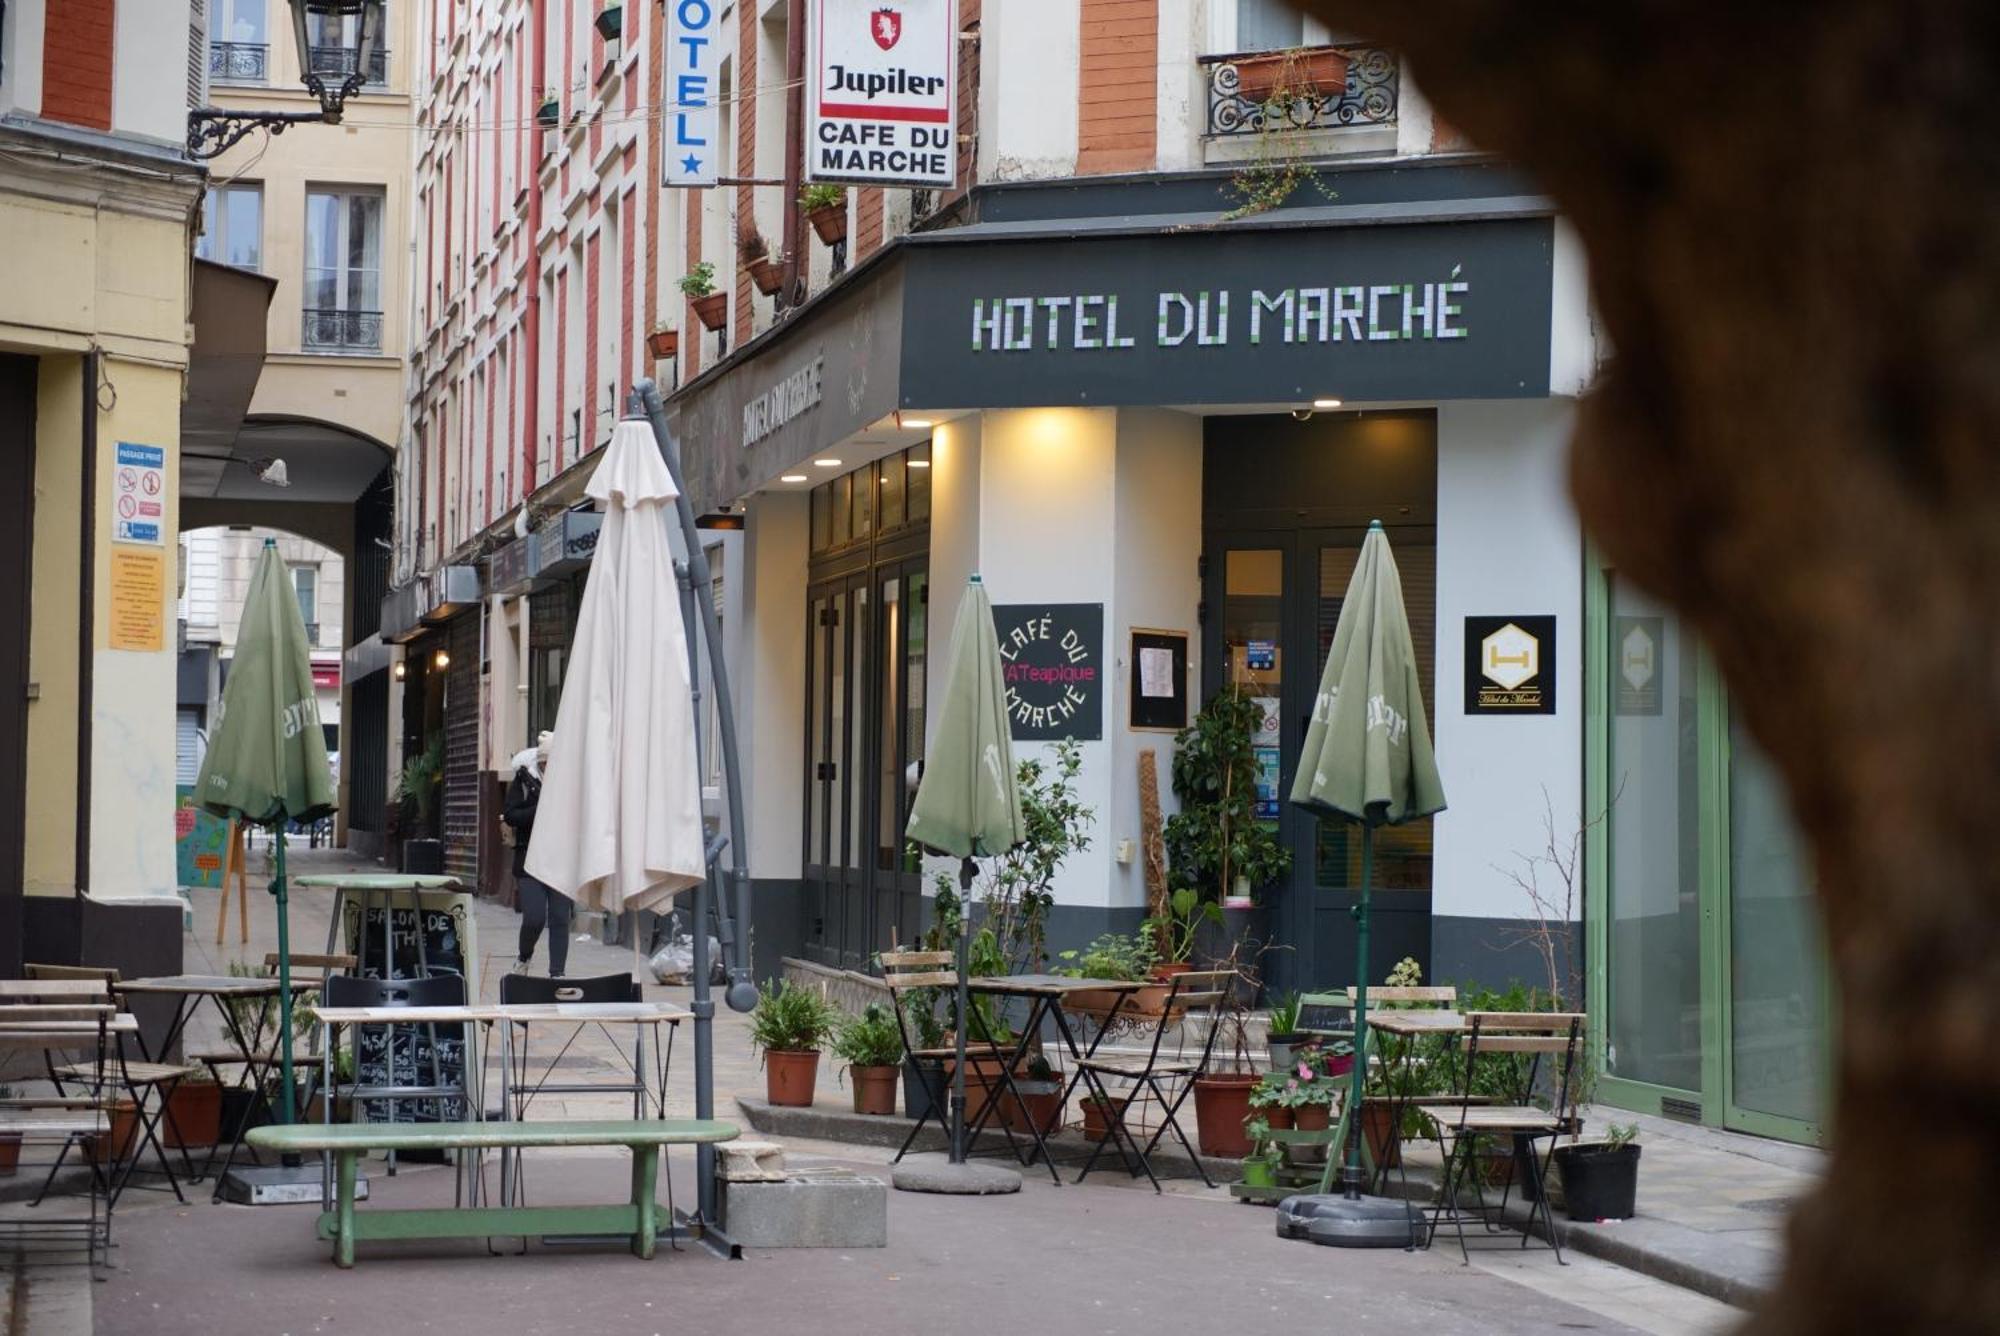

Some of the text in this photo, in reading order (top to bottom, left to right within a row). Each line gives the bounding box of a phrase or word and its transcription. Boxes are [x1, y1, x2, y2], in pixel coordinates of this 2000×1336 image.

[826, 65, 944, 99] Jupiler
[819, 122, 949, 149] CAFE DU
[821, 149, 947, 175] MARCHE
[972, 263, 1469, 351] HOTEL DU MARCHÉ
[999, 612, 1088, 664] CAFÉ DU
[1004, 683, 1087, 728] MARCHÉ
[427, 914, 449, 931] DE
